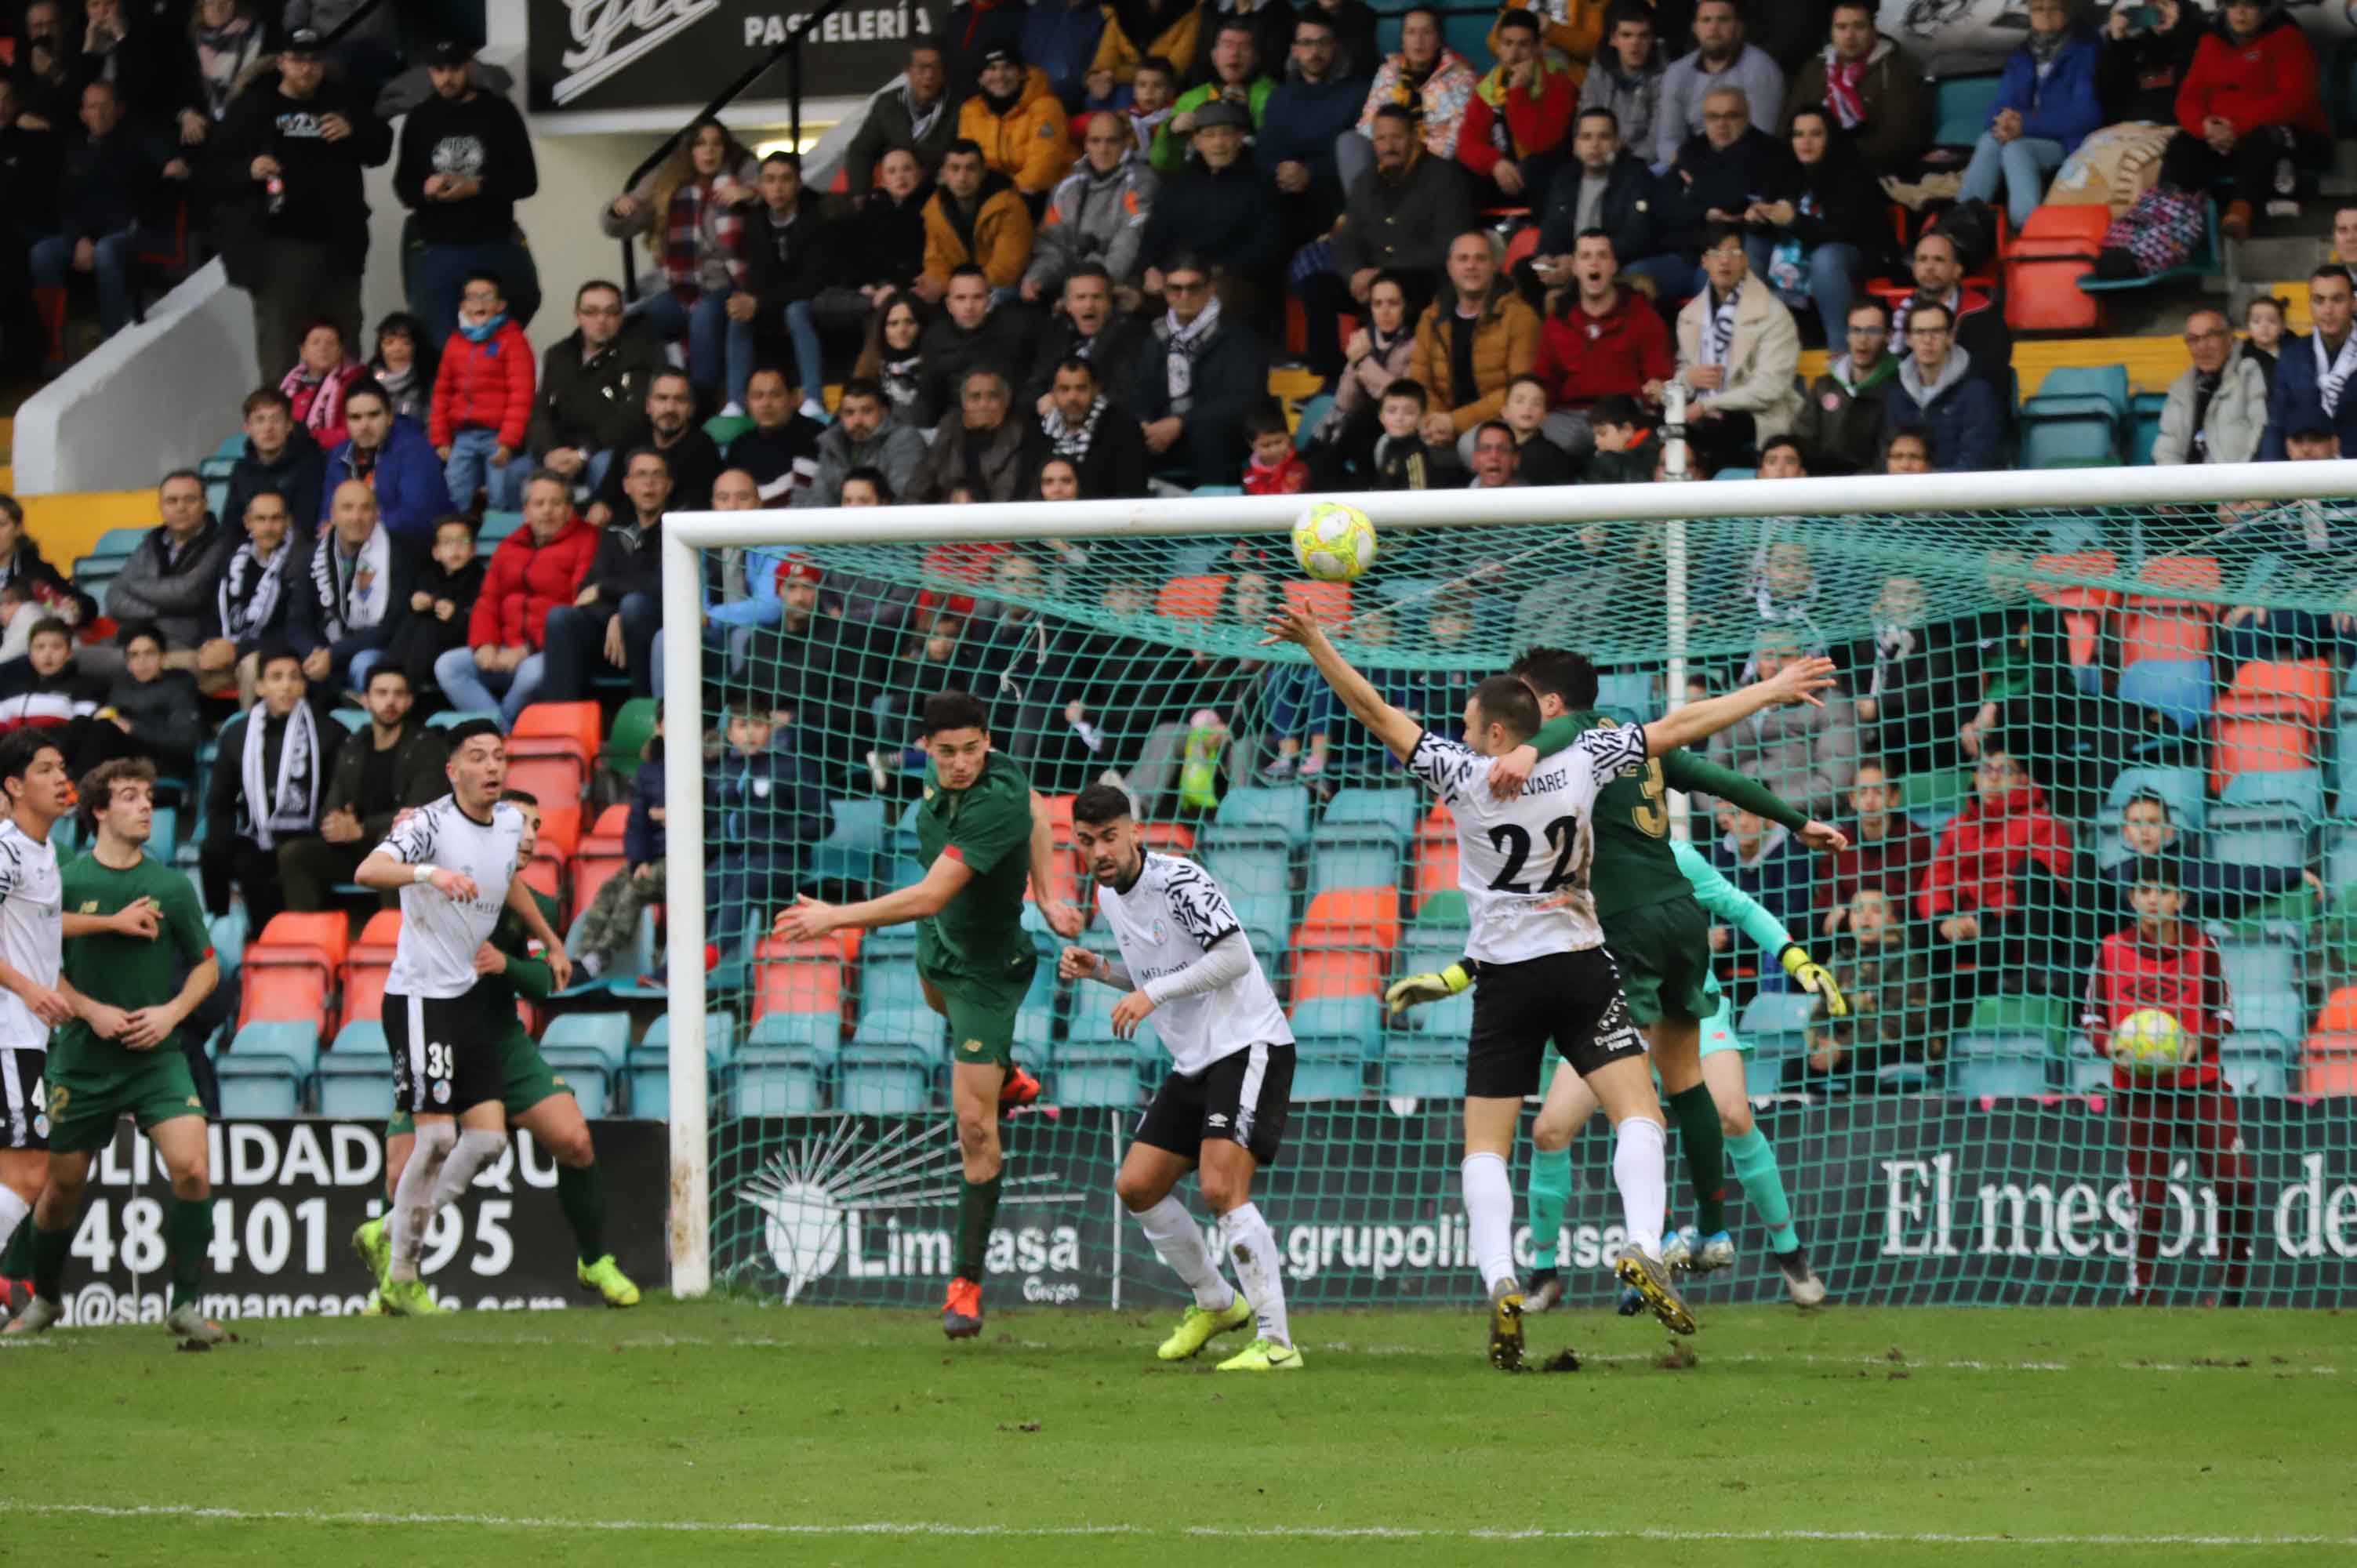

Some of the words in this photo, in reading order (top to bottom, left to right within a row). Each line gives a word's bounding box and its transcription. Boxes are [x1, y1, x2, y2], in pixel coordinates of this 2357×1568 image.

[1509, 768, 1569, 797] LVAREZ
[1617, 756, 1669, 839] 3
[1487, 815, 1578, 895] 22
[366, 1199, 514, 1276] 95
[1881, 1152, 1959, 1256] El
[848, 1210, 1080, 1278] Limasa
